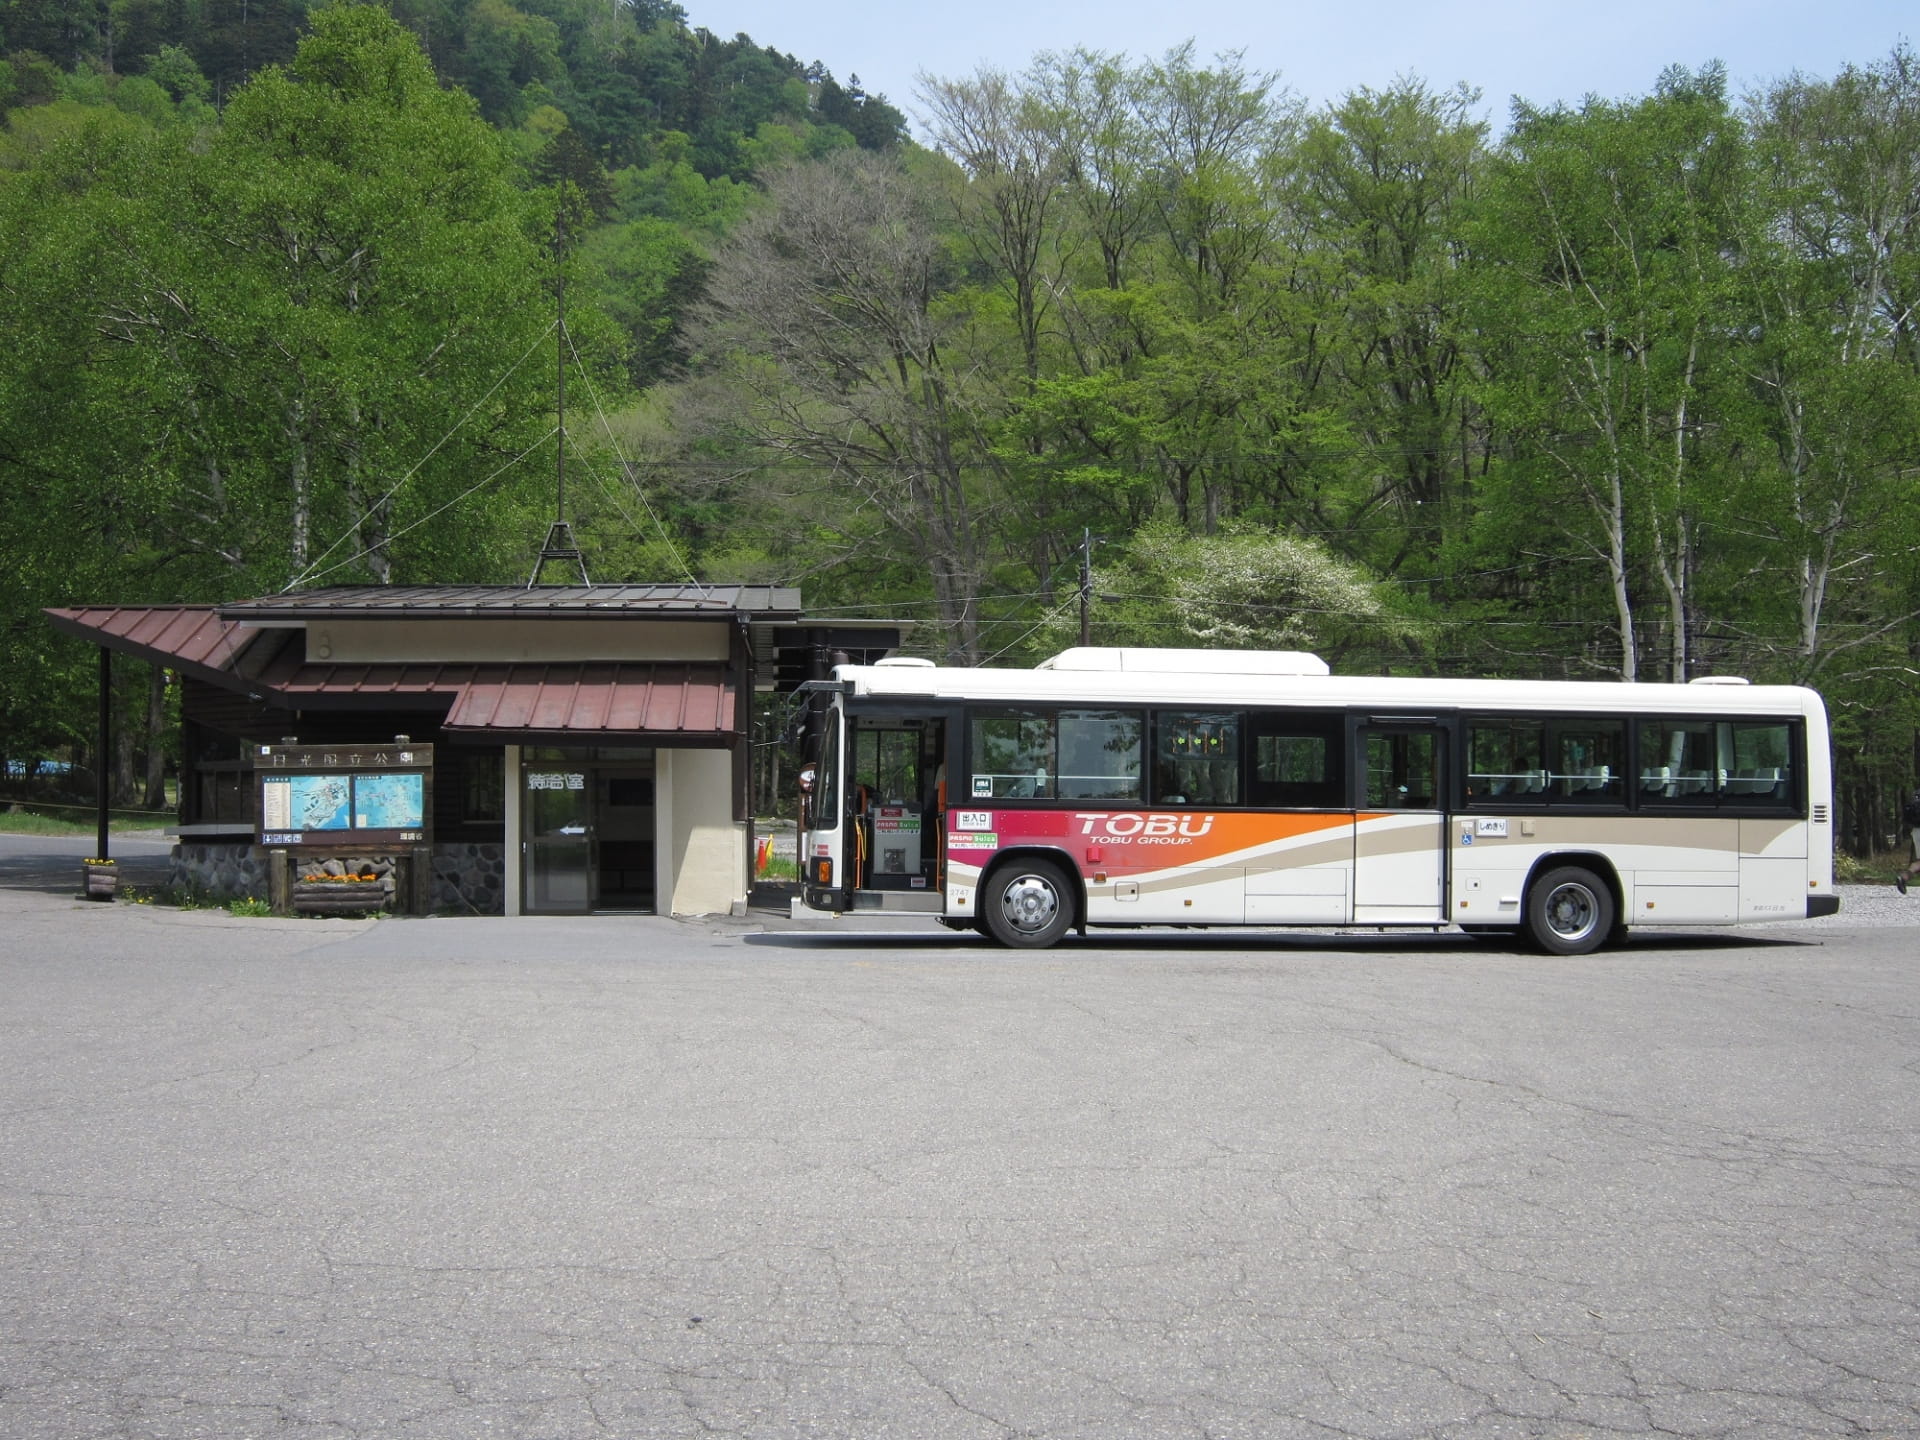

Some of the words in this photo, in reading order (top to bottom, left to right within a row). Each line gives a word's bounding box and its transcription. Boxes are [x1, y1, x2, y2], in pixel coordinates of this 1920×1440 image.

[963, 813, 986, 822] 出入口
[1075, 813, 1215, 837] TOBU
[1480, 822, 1504, 831] しめきり
[1090, 836, 1132, 845] TOBU
